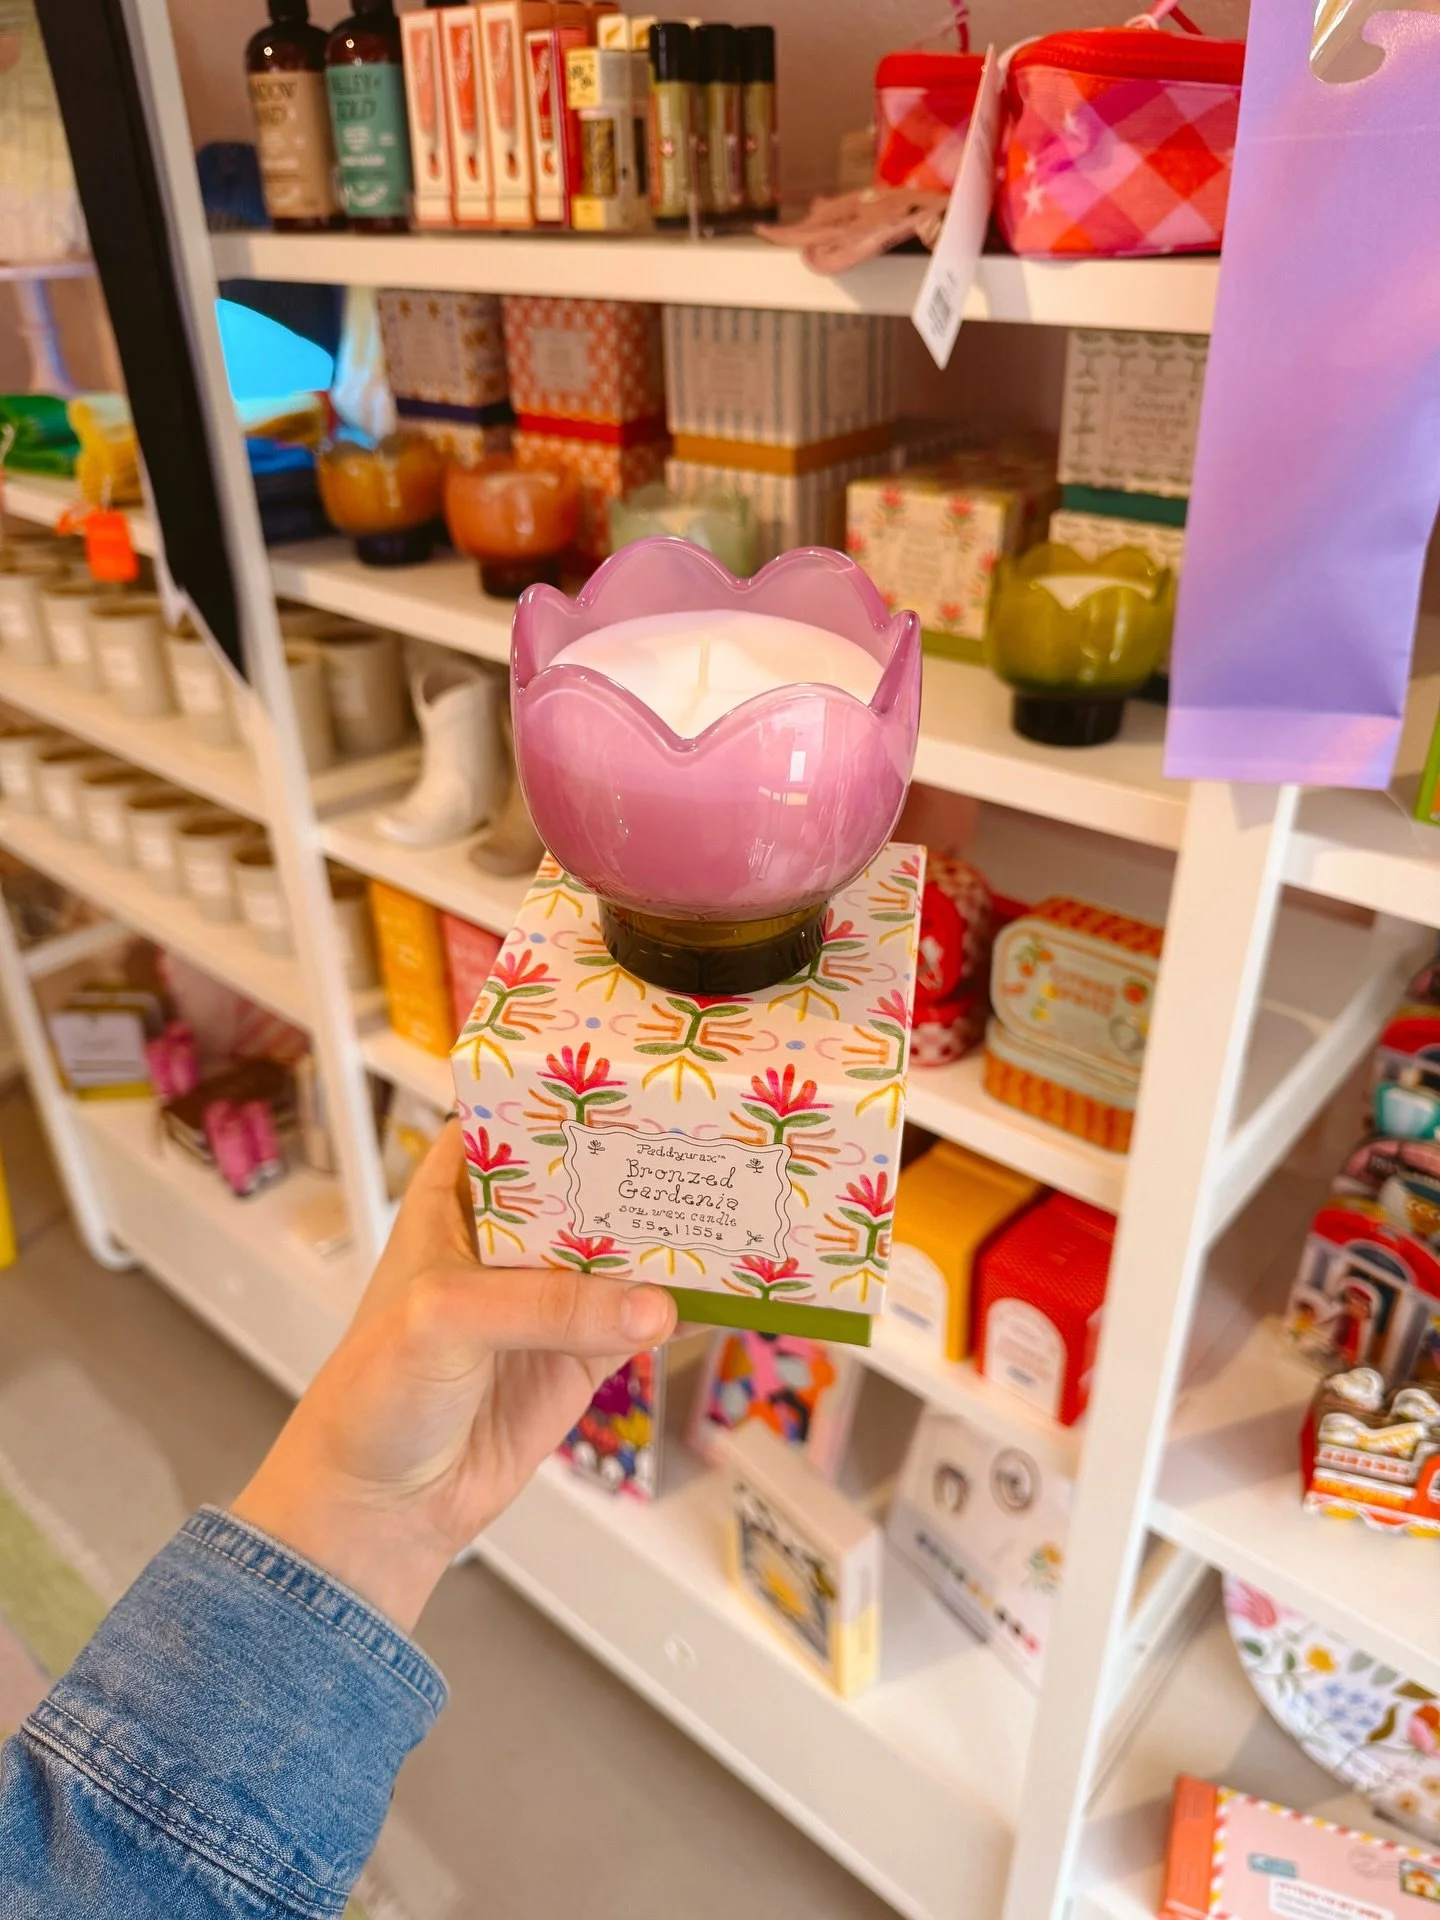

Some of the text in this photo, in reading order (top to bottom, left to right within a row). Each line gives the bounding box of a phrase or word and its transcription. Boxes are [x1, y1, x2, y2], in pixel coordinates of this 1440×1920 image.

[626, 1158, 736, 1189] Bronzed
[618, 1179, 739, 1211] Gardenia
[618, 1204, 737, 1227] soy wax candle
